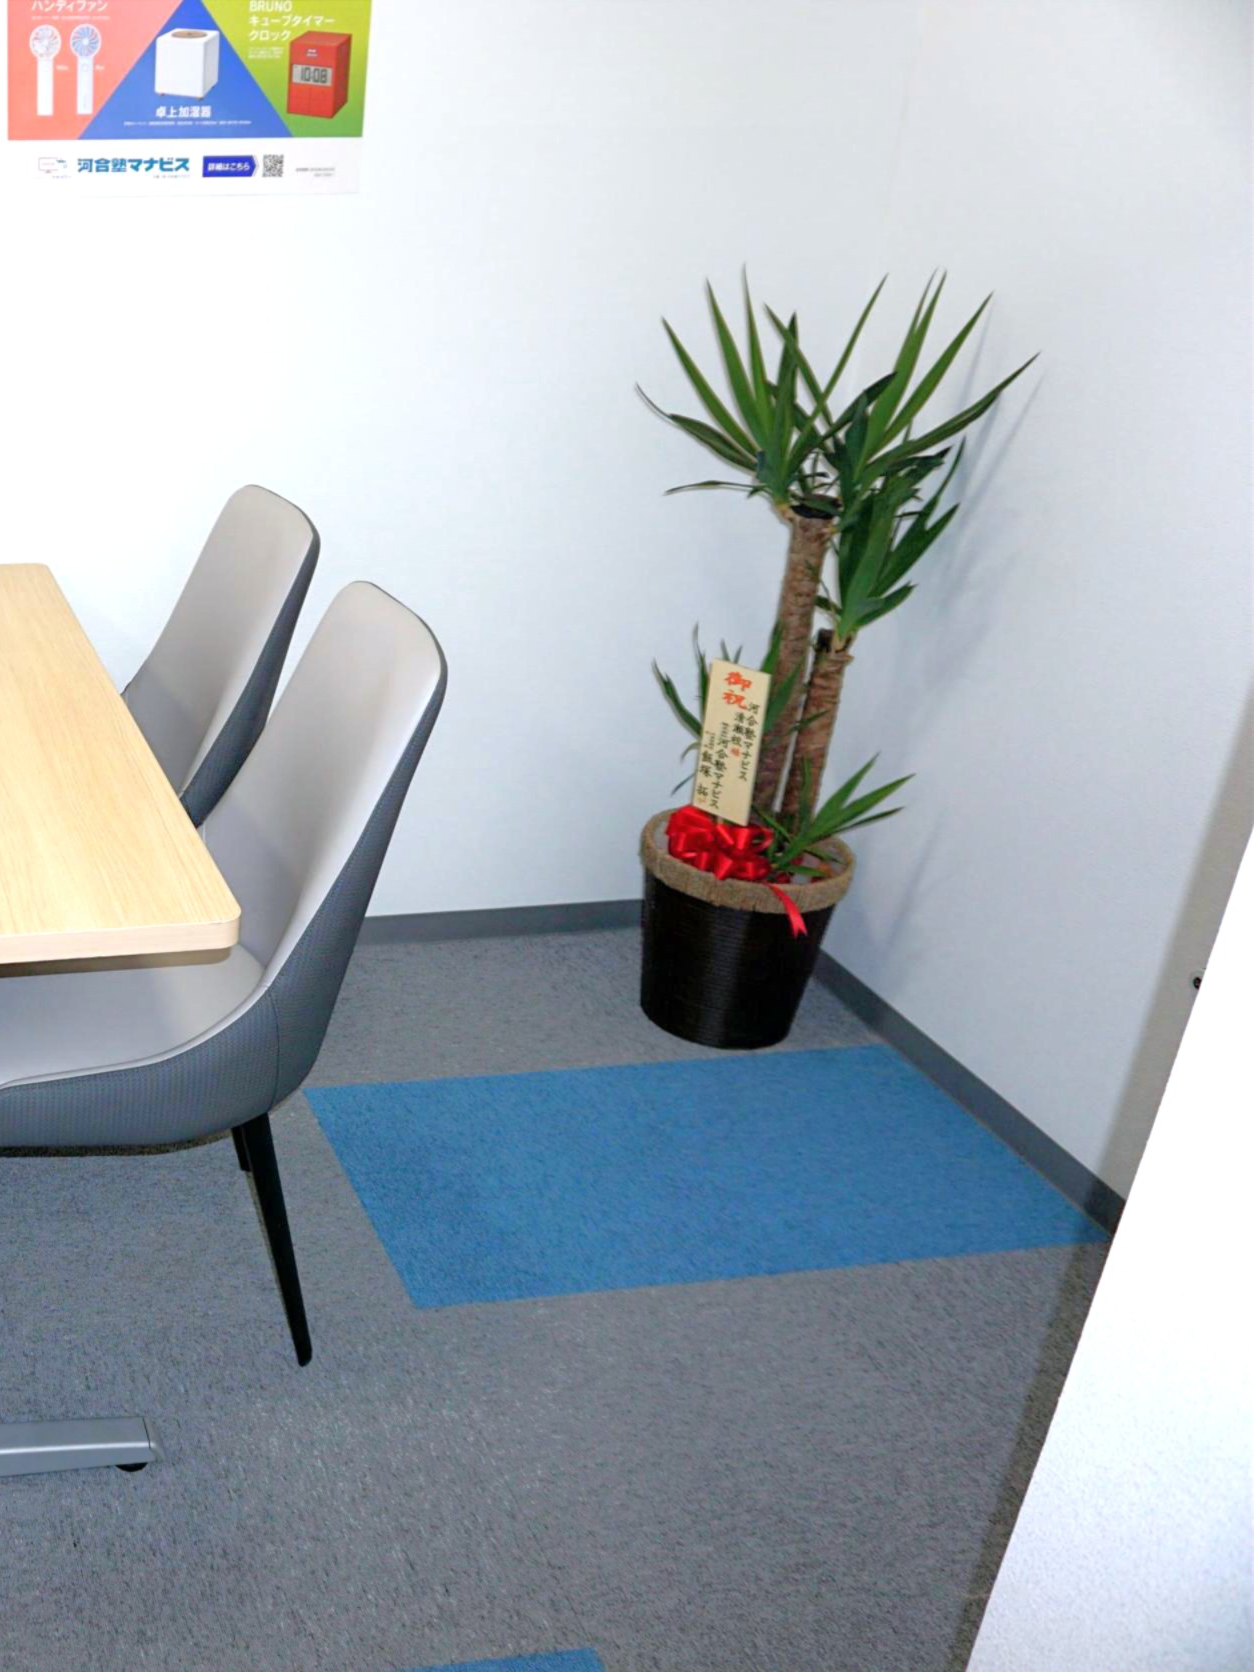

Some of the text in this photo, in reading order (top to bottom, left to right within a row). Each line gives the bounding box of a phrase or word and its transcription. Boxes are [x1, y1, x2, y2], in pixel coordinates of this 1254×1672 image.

[249, 0, 292, 12] BRUNO
[249, 15, 335, 27] キューブタイマー
[249, 29, 291, 41] クロック
[77, 157, 191, 173] 河合塾マナビス
[207, 162, 251, 172] 詳細はこちら
[722, 670, 753, 711] 御祝
[737, 702, 761, 782] 河合塾マナビス
[709, 736, 731, 809] 河合塾マナビス
